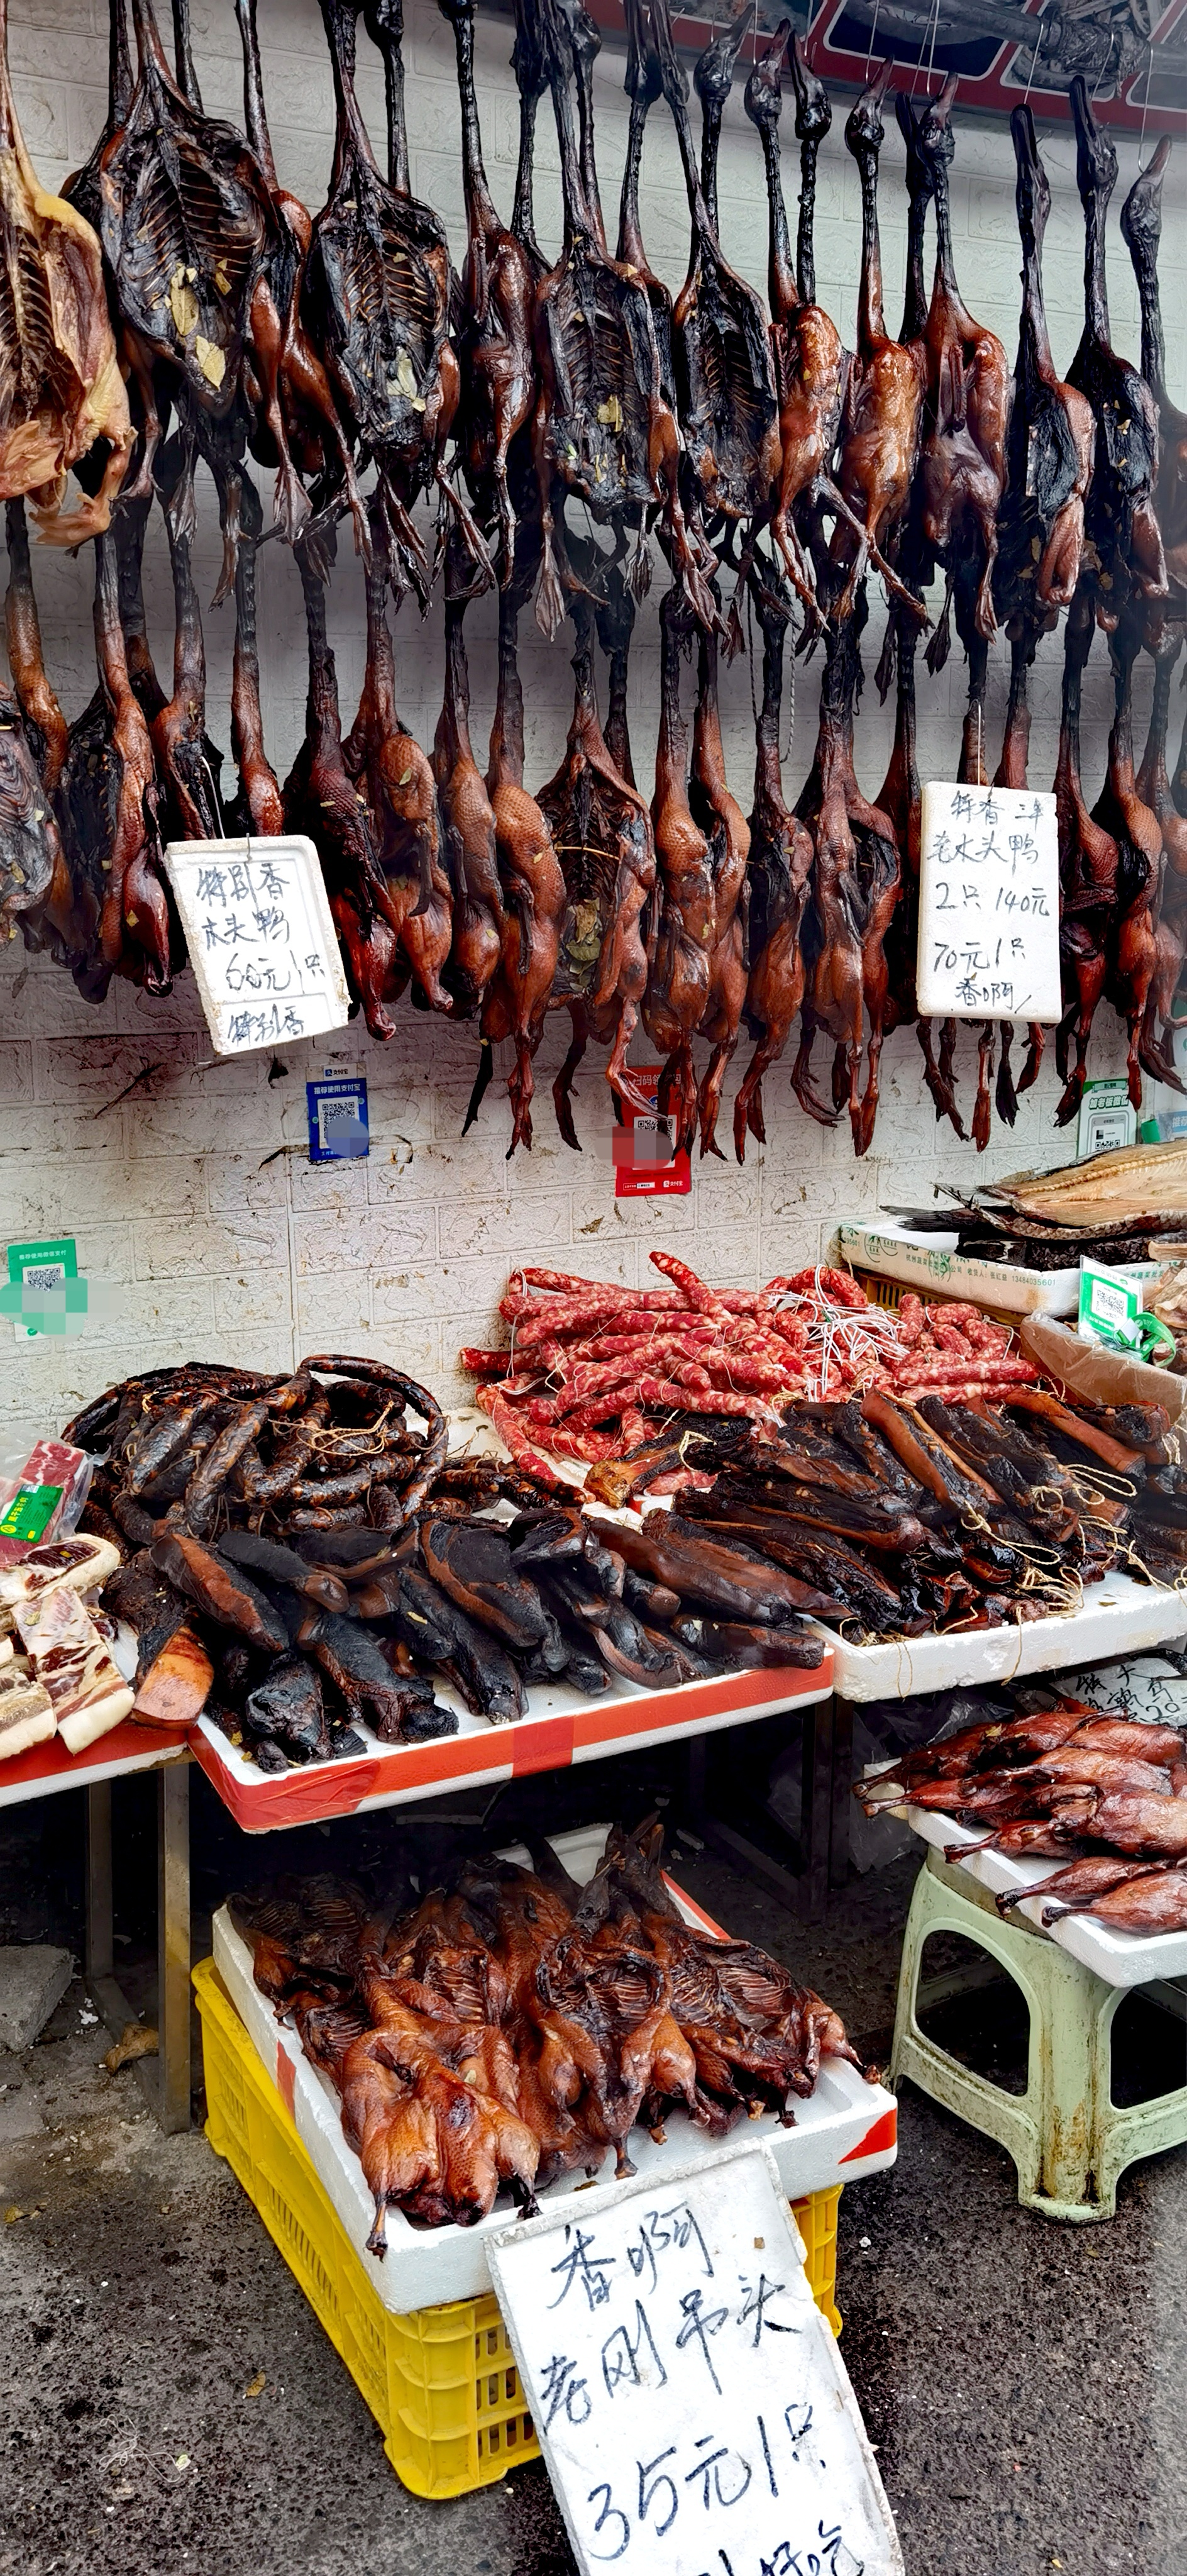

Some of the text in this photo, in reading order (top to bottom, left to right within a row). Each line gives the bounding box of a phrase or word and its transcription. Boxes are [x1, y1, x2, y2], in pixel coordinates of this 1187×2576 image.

[936, 882, 1050, 916] 2只 140元
[933, 937, 1025, 972] 70元1只
[314, 1084, 361, 1095] 推荐使用支付宝
[587, 2402, 827, 2562] 35元1只
